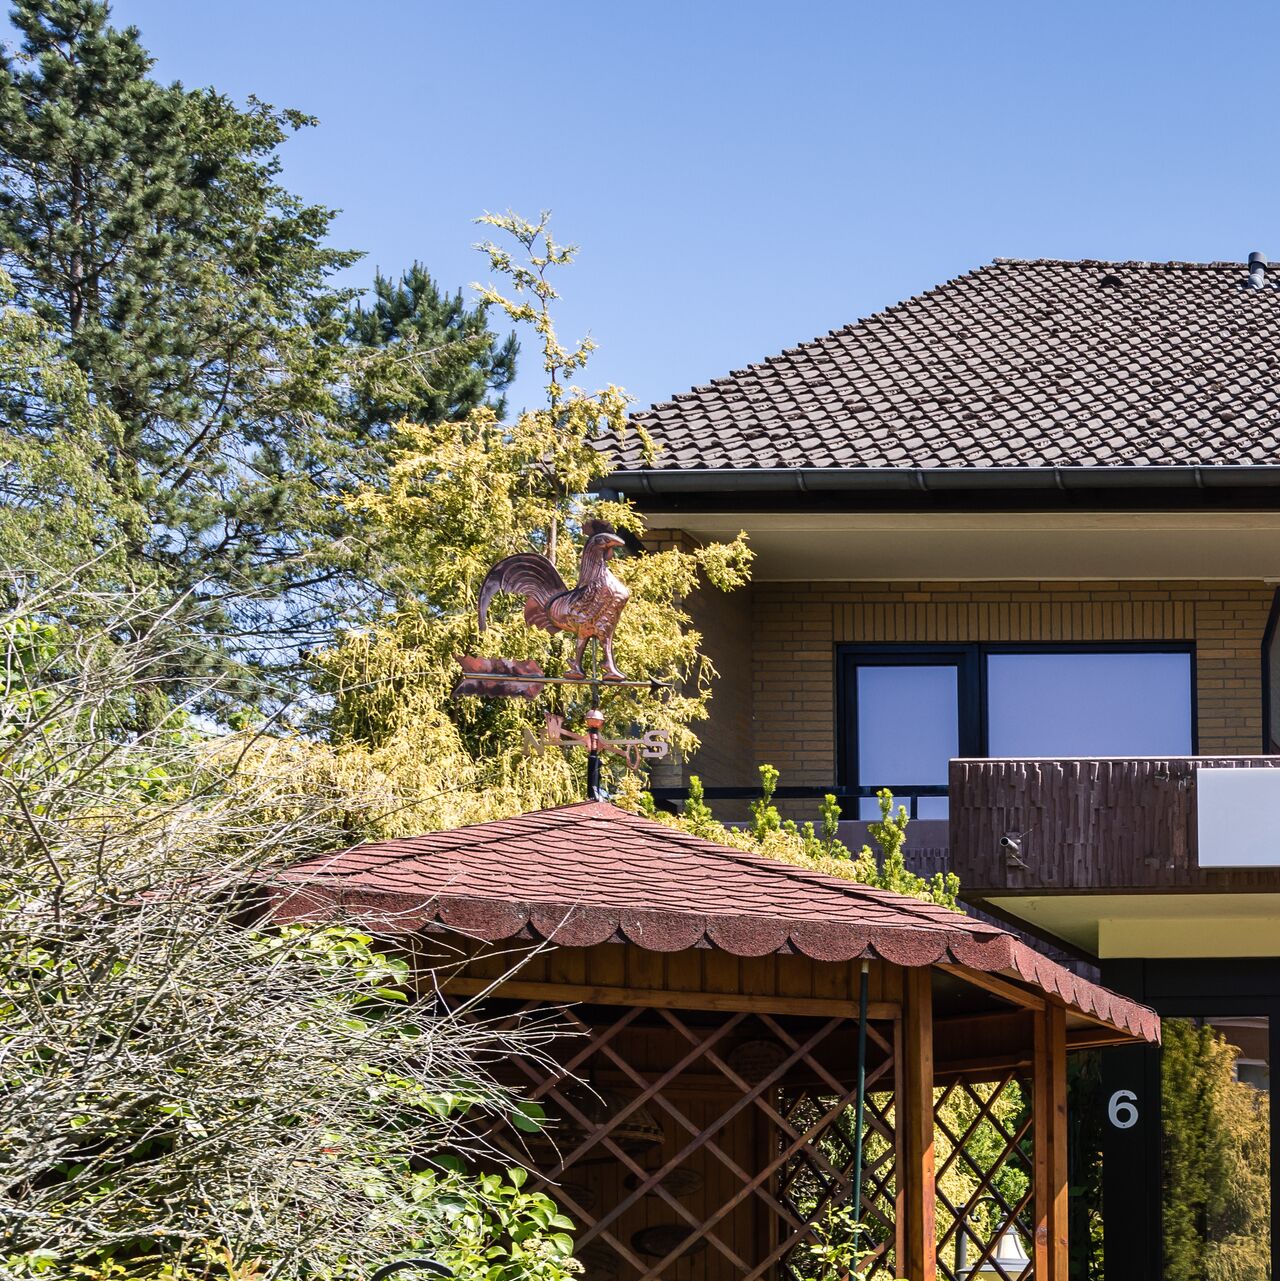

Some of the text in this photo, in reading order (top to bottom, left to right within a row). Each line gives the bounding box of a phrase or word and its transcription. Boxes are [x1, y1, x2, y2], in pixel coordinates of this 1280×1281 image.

[522, 727, 544, 755] N
[642, 729, 668, 758] S
[1108, 1089, 1139, 1129] 6
